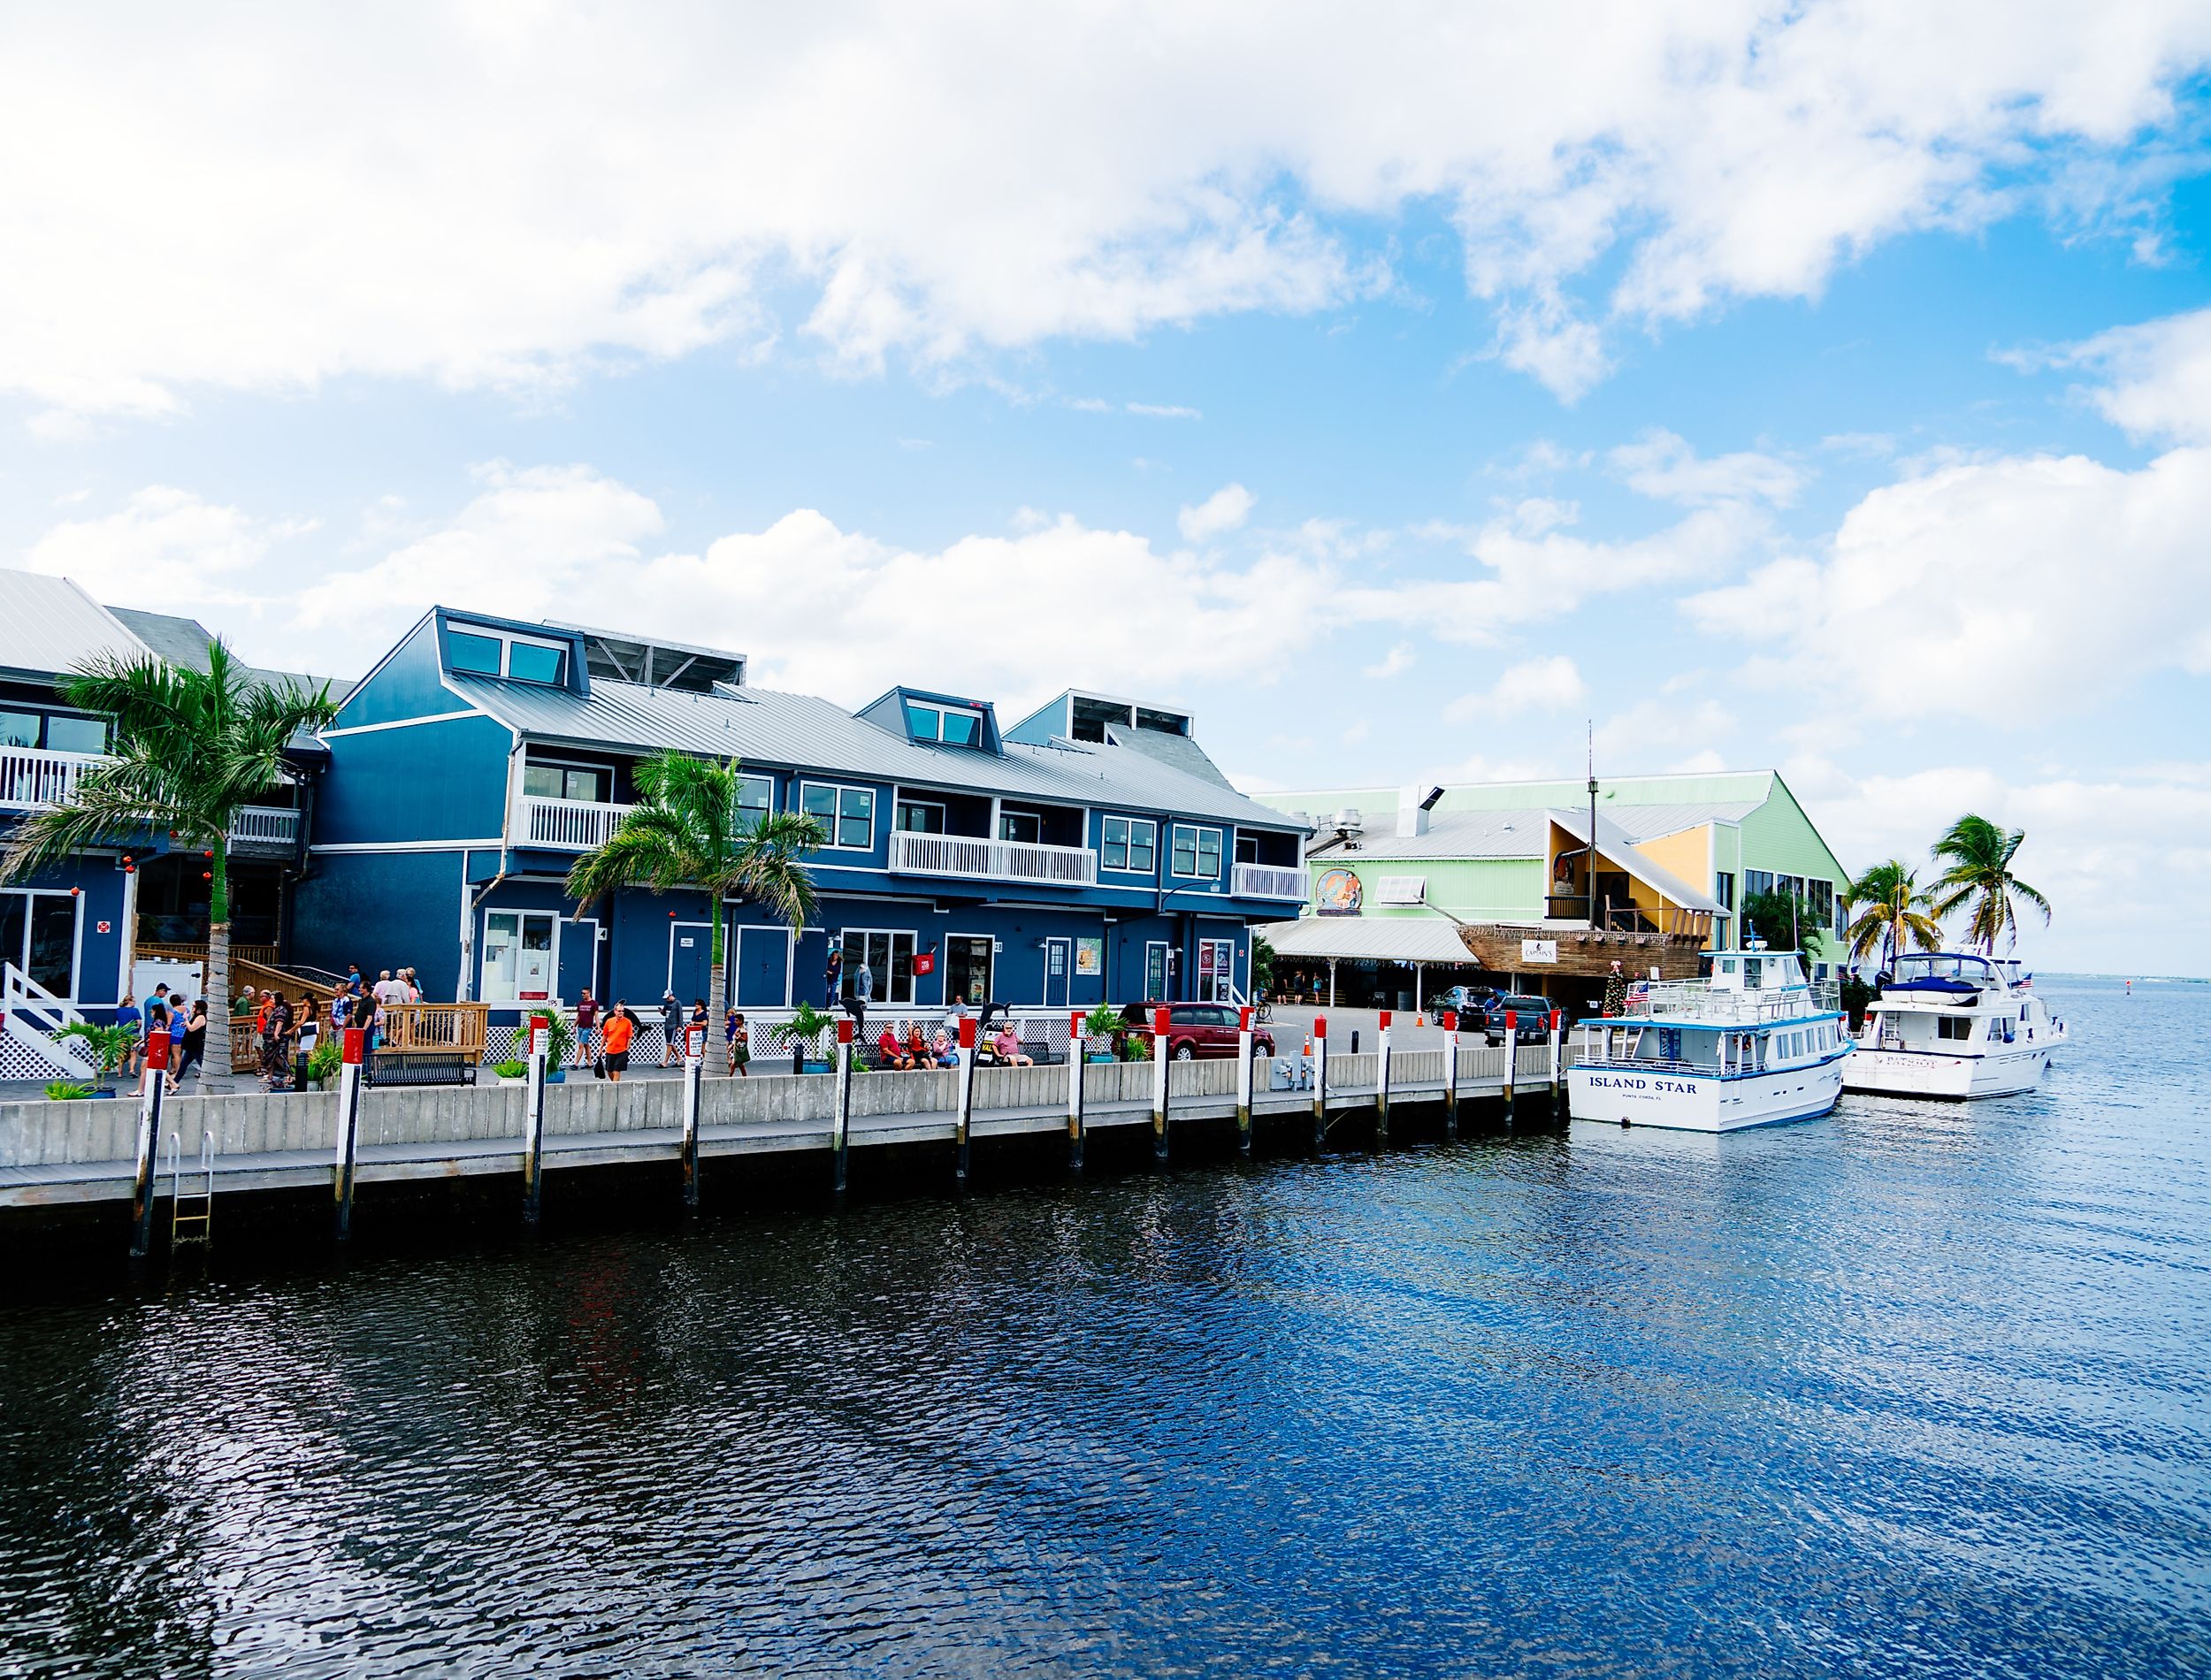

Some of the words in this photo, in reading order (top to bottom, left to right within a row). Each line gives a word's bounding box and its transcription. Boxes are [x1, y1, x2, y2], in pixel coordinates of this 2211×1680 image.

[600, 929, 606, 938] 4
[1589, 1077, 1646, 1089] ISLAND
[1655, 1081, 1697, 1095] STAR
